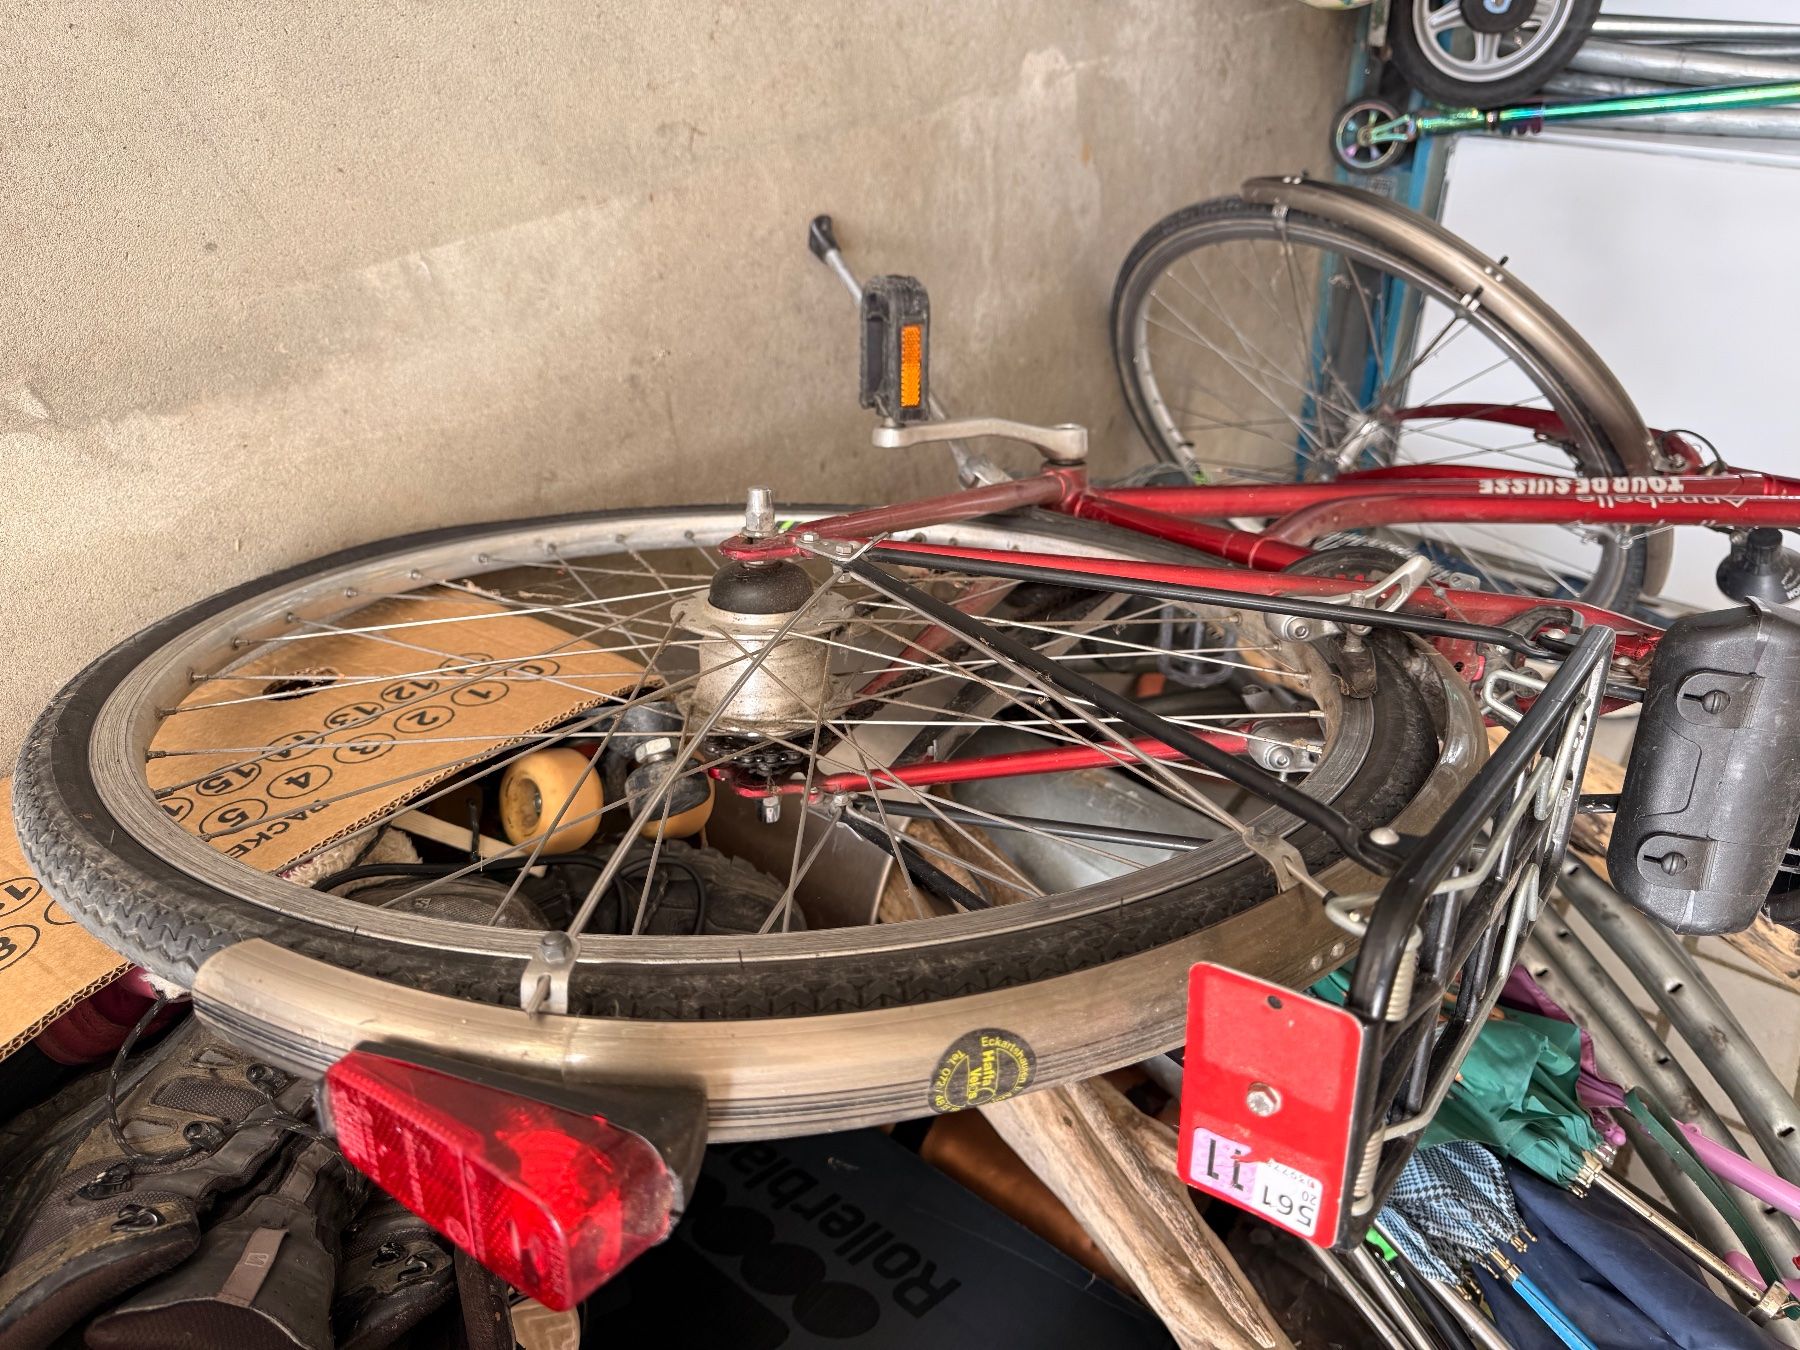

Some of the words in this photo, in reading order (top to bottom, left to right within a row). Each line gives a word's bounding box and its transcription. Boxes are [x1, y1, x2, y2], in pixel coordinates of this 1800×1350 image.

[1479, 477, 1573, 495] SUISSE
[1575, 476, 1608, 494] DE
[1612, 476, 1684, 494] TOUR
[385, 680, 434, 700] 12
[467, 688, 492, 700] 1
[406, 710, 440, 726] 2
[202, 765, 255, 794] 15
[284, 771, 312, 790] 4
[217, 807, 250, 828] 5
[1262, 1185, 1314, 1228] 561
[1302, 1191, 1317, 1206] 20
[705, 1143, 961, 1319] Rollerbla
